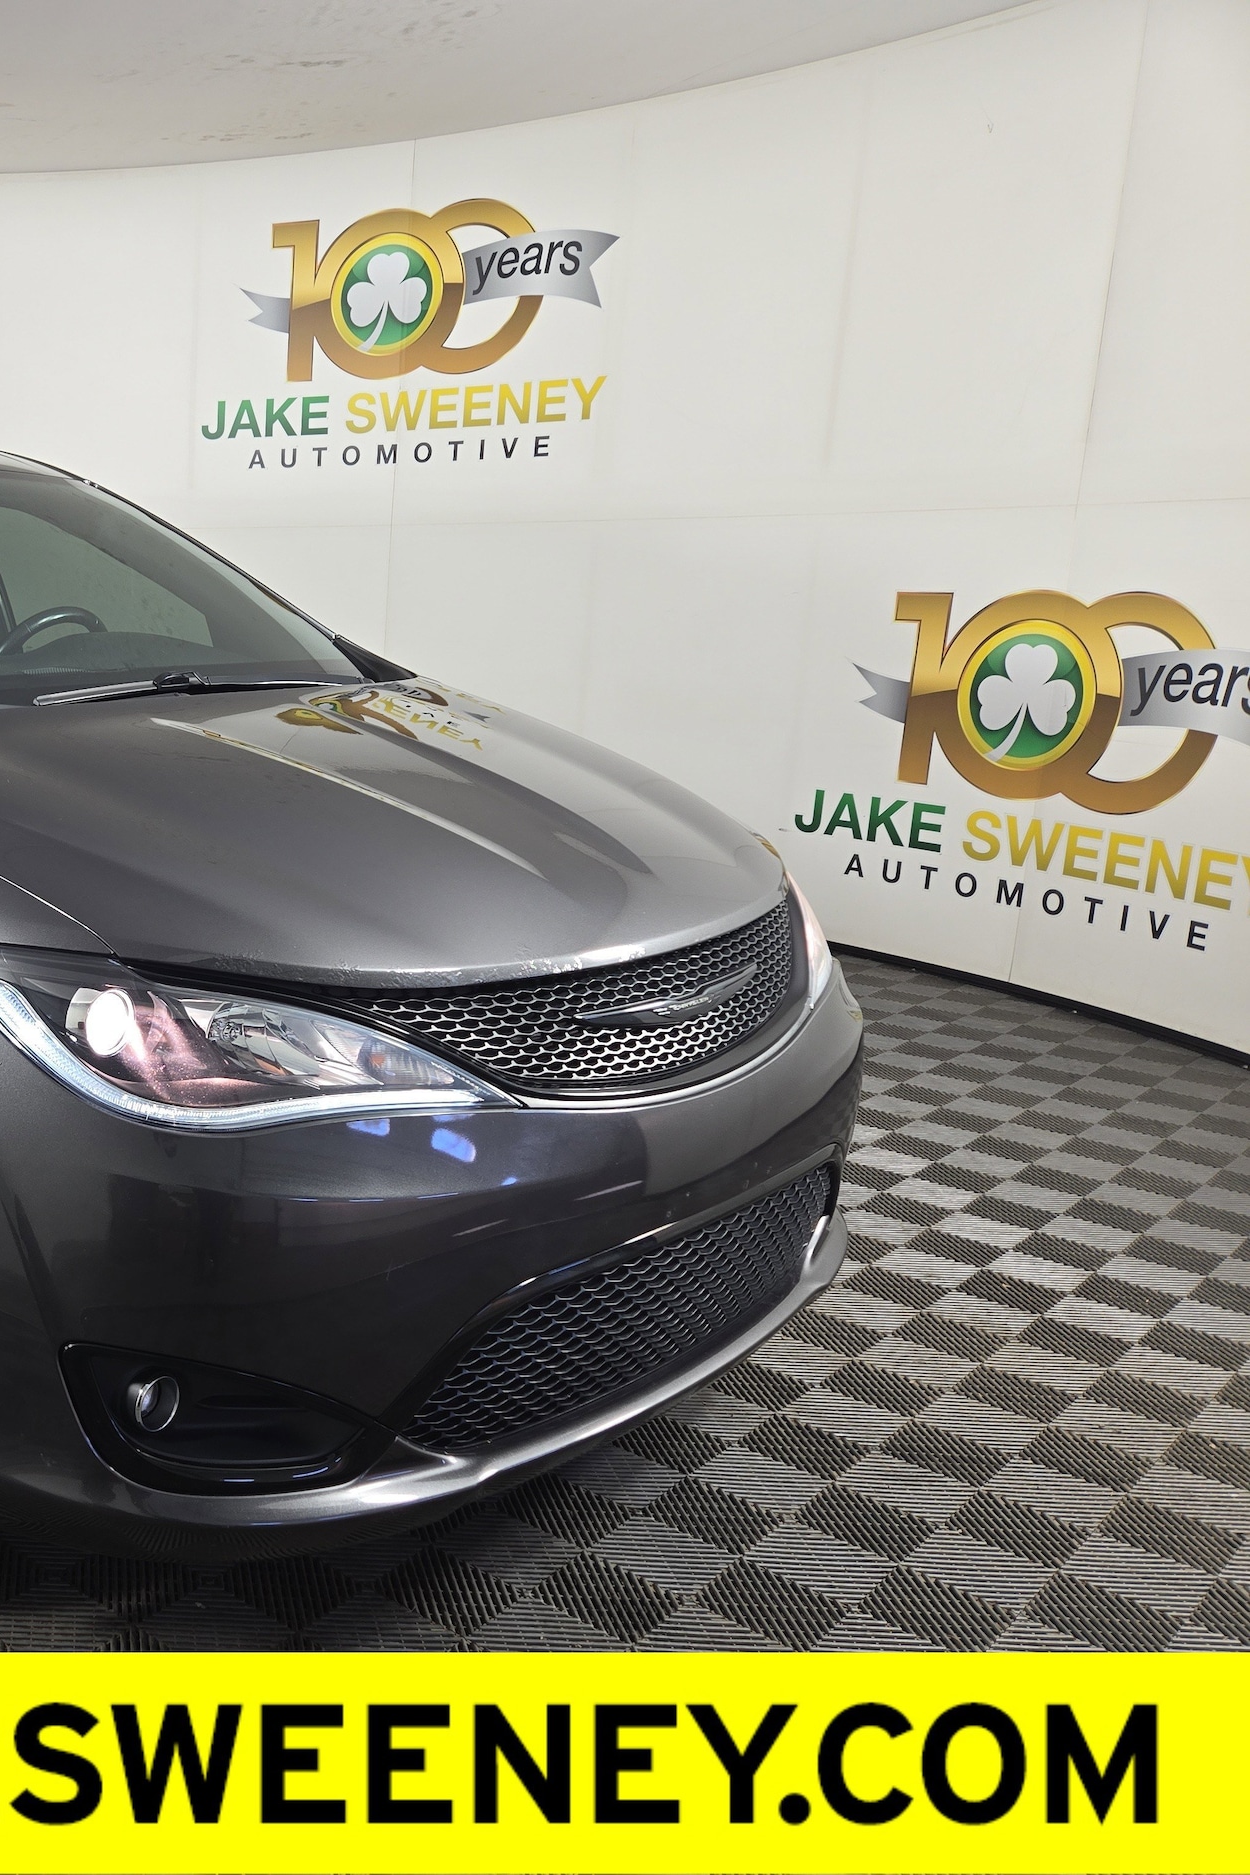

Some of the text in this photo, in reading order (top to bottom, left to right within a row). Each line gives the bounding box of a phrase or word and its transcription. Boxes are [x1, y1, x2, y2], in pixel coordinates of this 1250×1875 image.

[472, 235, 583, 296] years
[201, 376, 607, 440] JAKE SWEENEY
[249, 436, 550, 469] AUTOMOTIVE
[794, 789, 1250, 915] JAKE SWEENE
[845, 854, 1209, 951] AUTOMOTIVE
